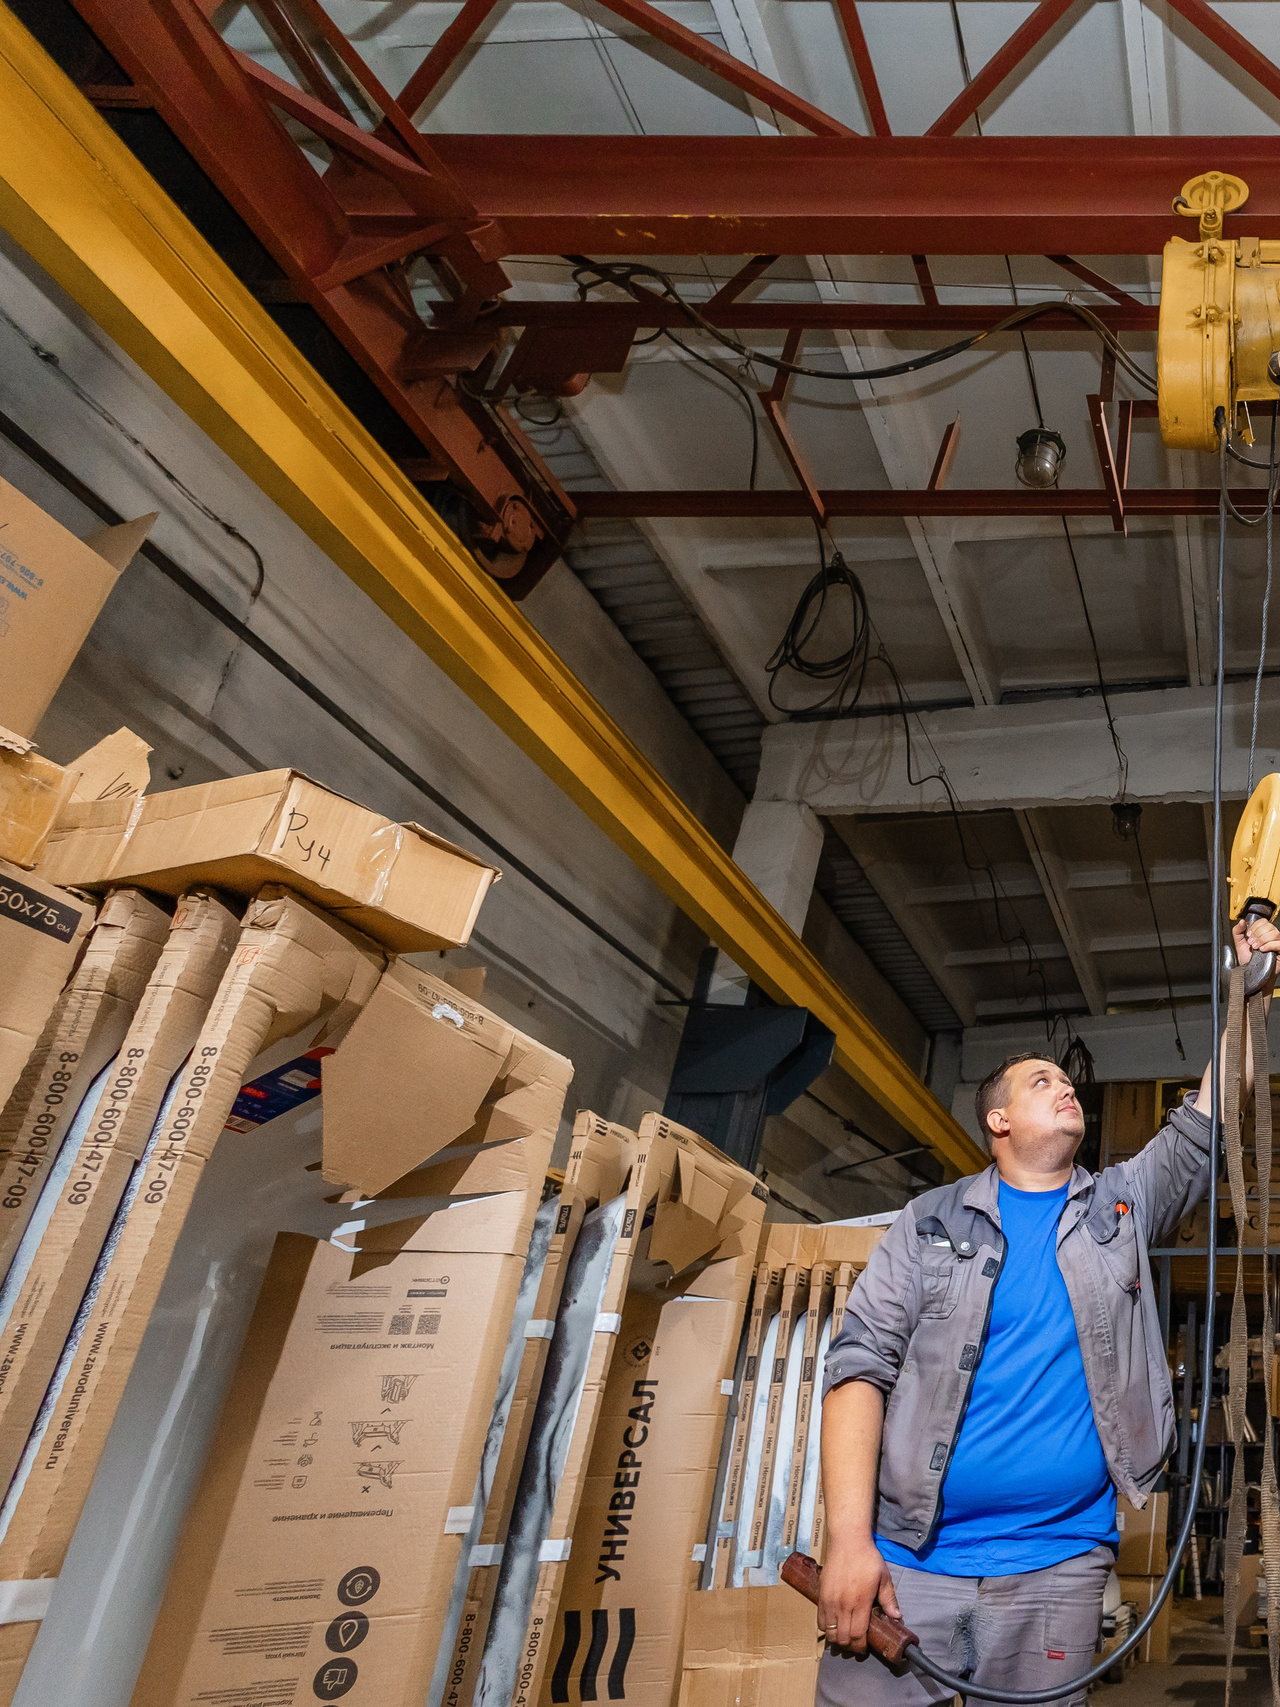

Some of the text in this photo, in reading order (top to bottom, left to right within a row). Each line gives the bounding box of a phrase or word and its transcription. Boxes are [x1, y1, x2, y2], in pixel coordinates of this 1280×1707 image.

[2, 1051, 79, 1209] 8-800-600-47-09
[68, 1047, 145, 1205] 8-800-600-47-09
[144, 1046, 218, 1204] 8-800-600-47-09
[330, 1341, 392, 1350] эксплуатация
[400, 1342, 435, 1350] Монтаж
[44, 1321, 109, 1470] www.zavoduniversal.ru
[736, 1435, 745, 1453] Нега
[765, 1436, 773, 1454] Нега
[594, 1380, 659, 1585] УНИВЕРСАЛ
[758, 1466, 769, 1508] Ностальжи
[272, 1513, 318, 1522] хранение
[327, 1508, 394, 1519] Перемещение
[813, 1517, 823, 1547] Оптима
